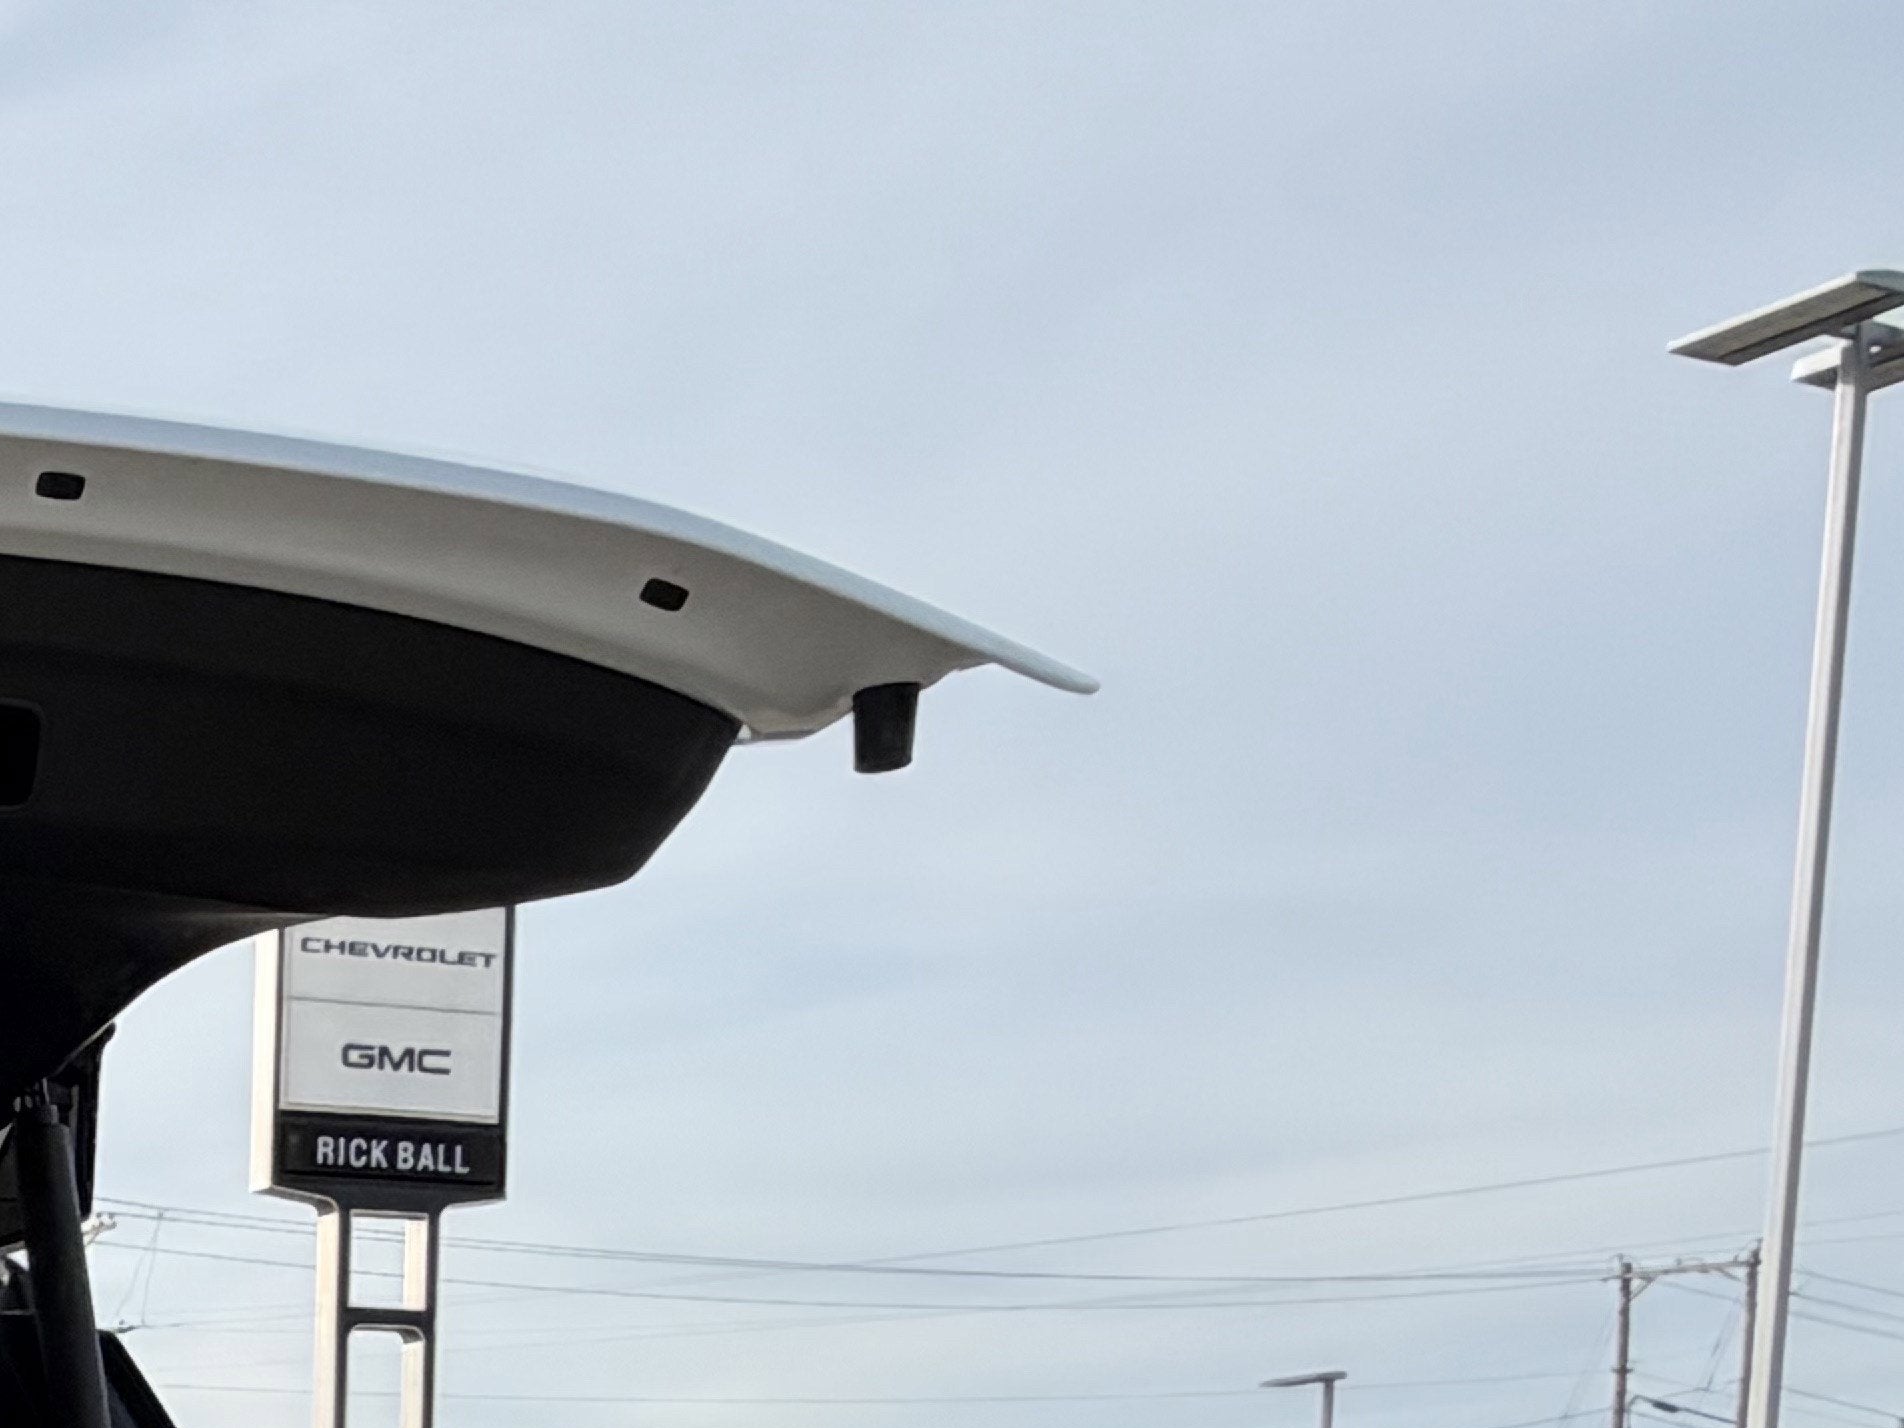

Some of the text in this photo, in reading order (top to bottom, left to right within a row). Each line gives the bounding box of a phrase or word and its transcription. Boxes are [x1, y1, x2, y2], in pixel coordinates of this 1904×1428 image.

[299, 936, 496, 968] CHEVROLET
[341, 1042, 452, 1076] GMC
[316, 1135, 470, 1175] RICK BALL
